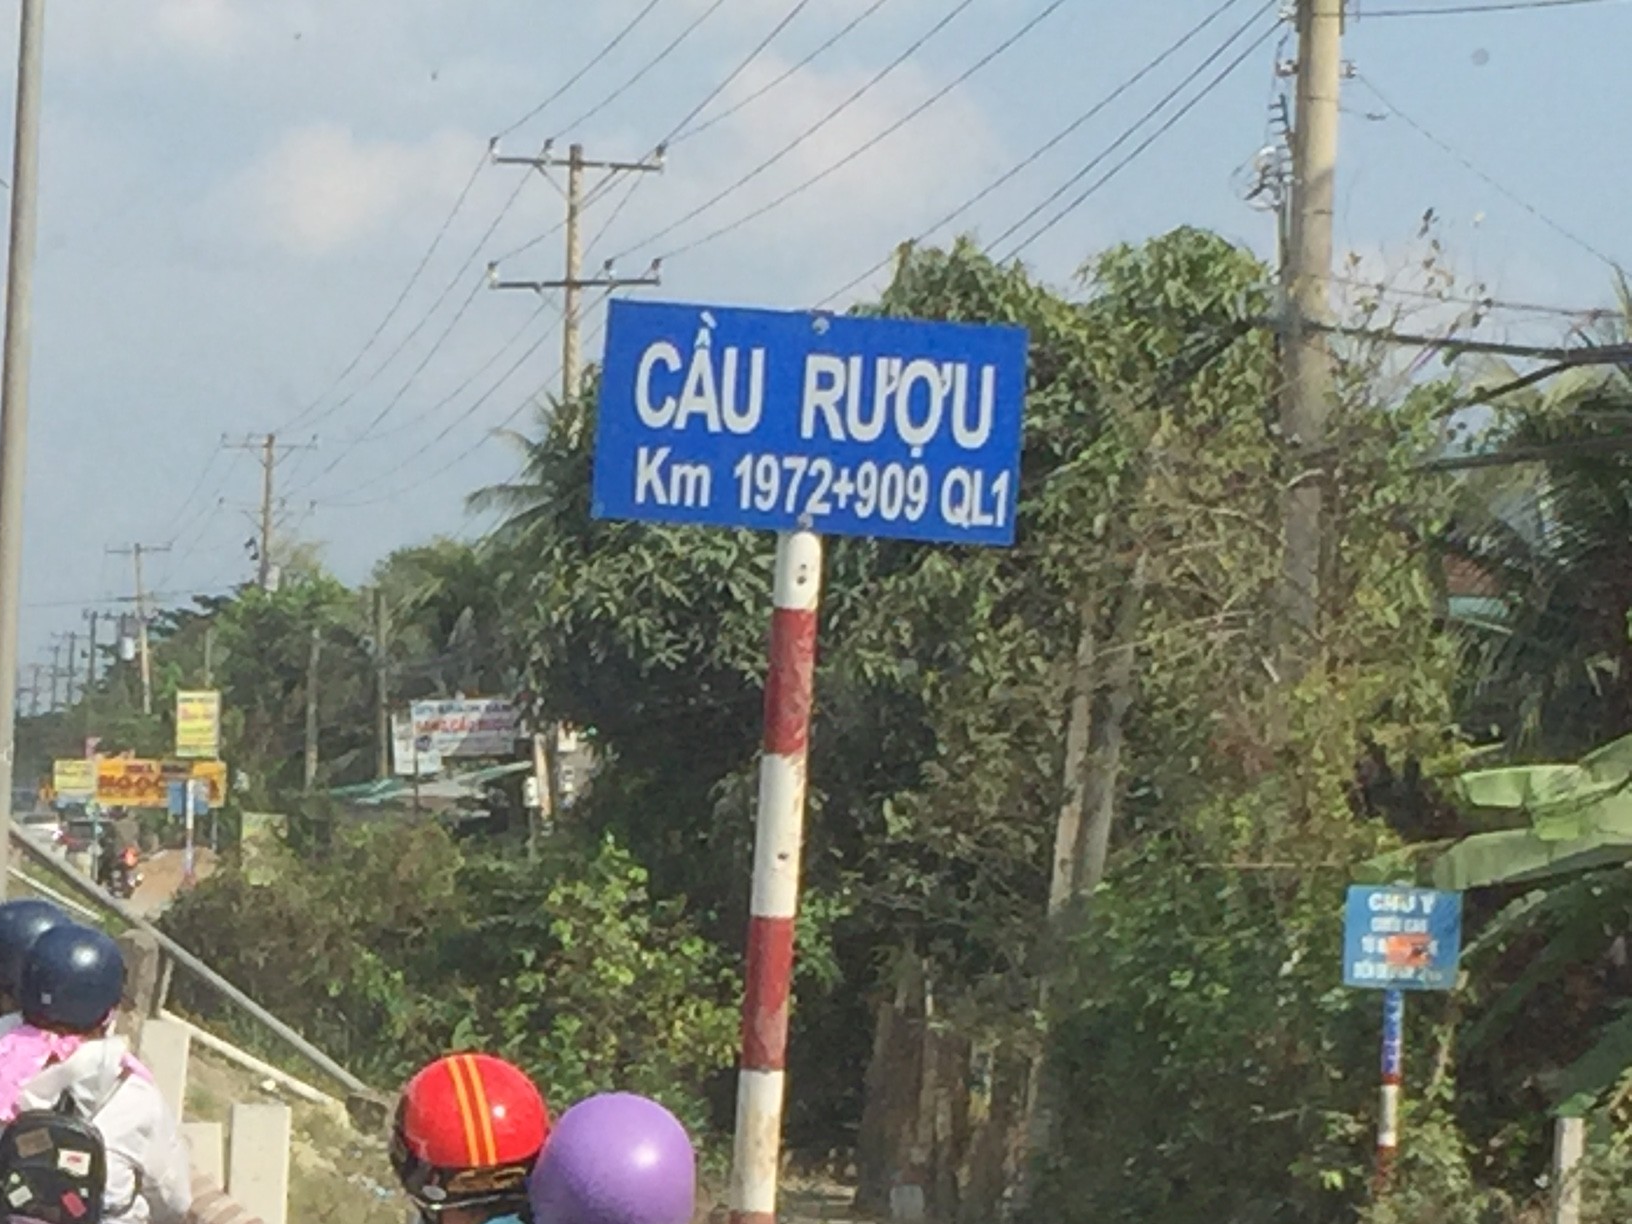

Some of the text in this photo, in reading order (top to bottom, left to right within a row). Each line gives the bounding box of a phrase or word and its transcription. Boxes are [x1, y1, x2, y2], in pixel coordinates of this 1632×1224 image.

[634, 311, 995, 458] CẦU RƯỢU
[634, 447, 1011, 529] Km 1972+909 QL1
